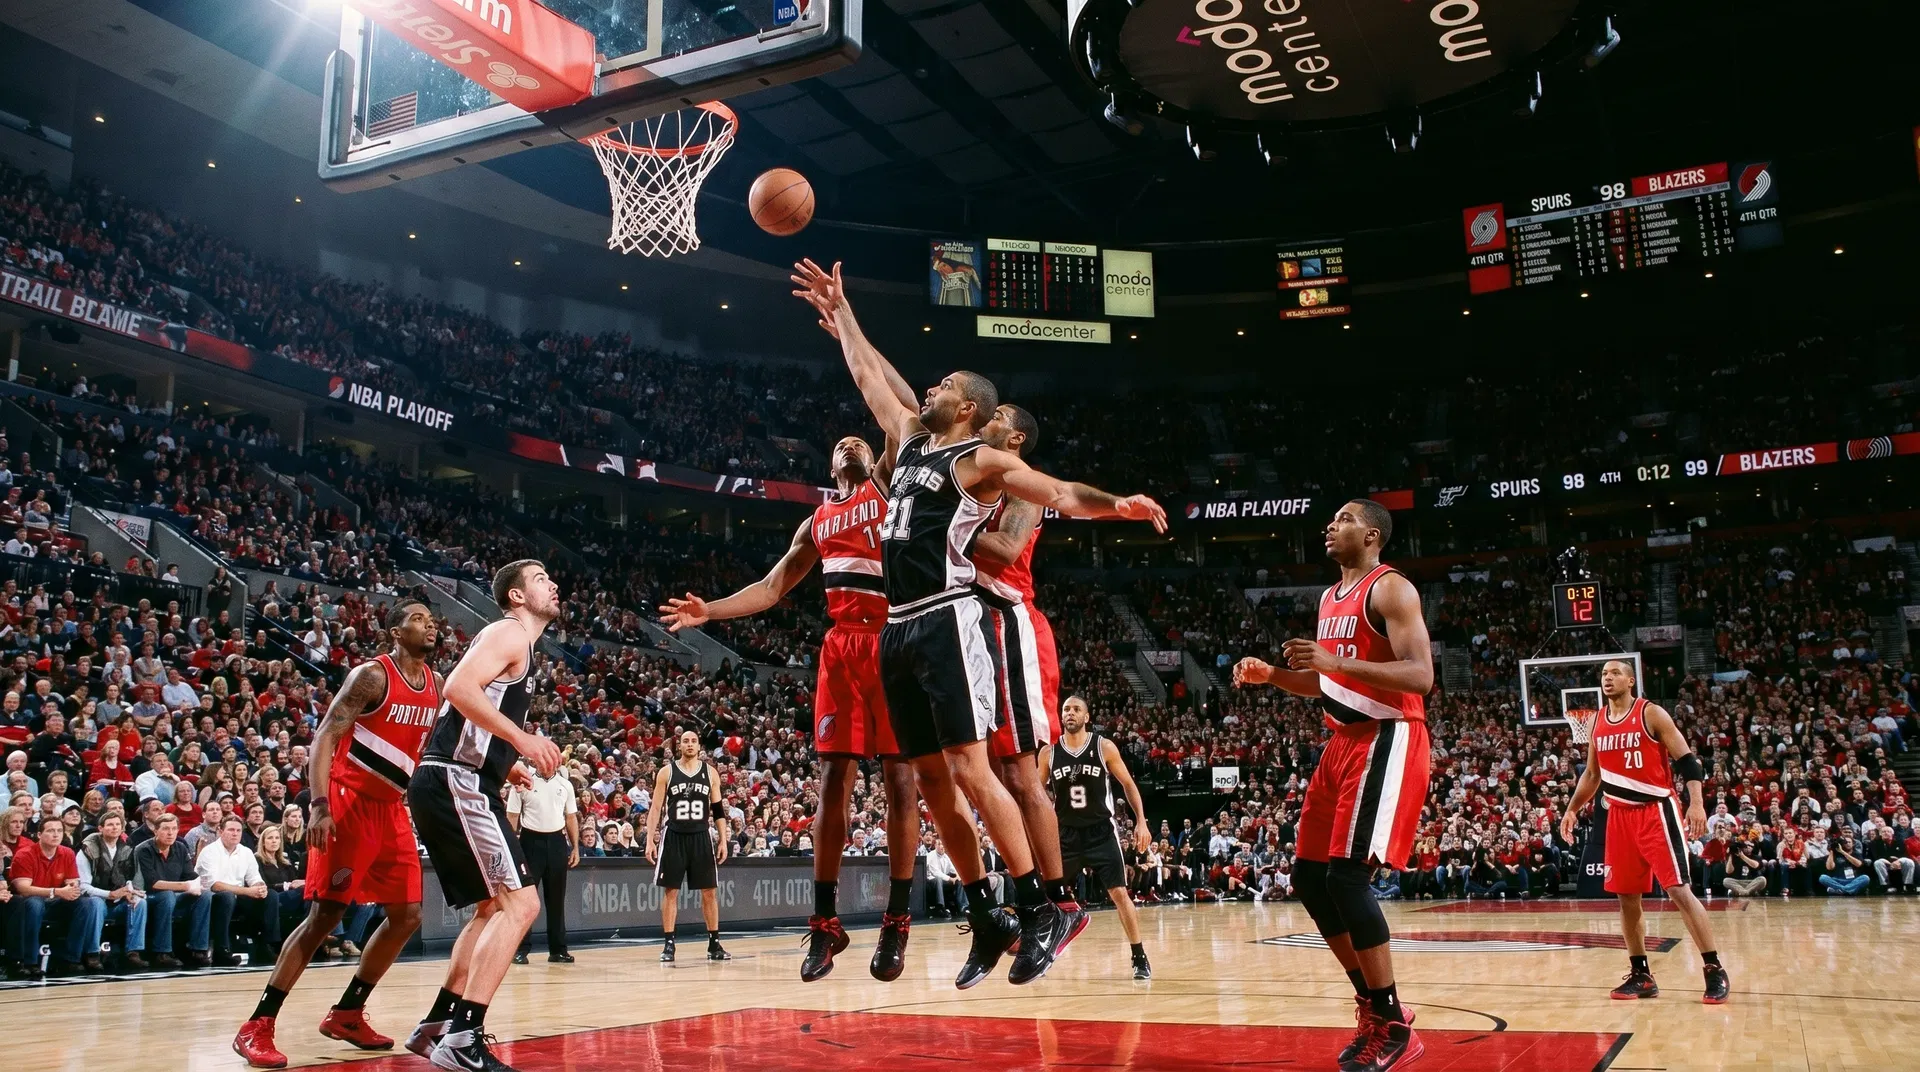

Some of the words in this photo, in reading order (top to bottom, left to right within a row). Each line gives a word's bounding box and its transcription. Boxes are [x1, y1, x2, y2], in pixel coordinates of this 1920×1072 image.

[1648, 169, 1707, 193] BLAZERS
[1600, 182, 1626, 201] 98
[1531, 192, 1572, 212] SPURS
[1740, 210, 1757, 222] 4TH
[1759, 207, 1777, 220] QTR
[1471, 254, 1486, 266] 4TH
[1487, 252, 1504, 265] QTR
[1106, 272, 1151, 286] moda
[1, 272, 63, 313] TRAIL
[1106, 284, 1151, 297] center
[992, 321, 1096, 339] modacenter
[348, 382, 382, 411] NBA
[386, 395, 454, 431] PLAYOFF
[1490, 478, 1540, 498] SPURS
[1563, 473, 1585, 490] 98
[1600, 471, 1621, 484] 4TH
[1637, 464, 1670, 482] 0:12
[1685, 459, 1708, 476] 99
[1740, 447, 1816, 471] BLAZERS
[1205, 502, 1237, 518] NBA
[1242, 498, 1311, 517] PLAYOFF
[1567, 586, 1595, 600] 0:12
[1573, 600, 1592, 621] 12
[1624, 750, 1643, 769] 20
[1070, 785, 1087, 809] 9
[676, 800, 704, 820] 29
[594, 883, 631, 913] NBA
[753, 879, 780, 906] 4TH
[785, 878, 812, 906] QTR
